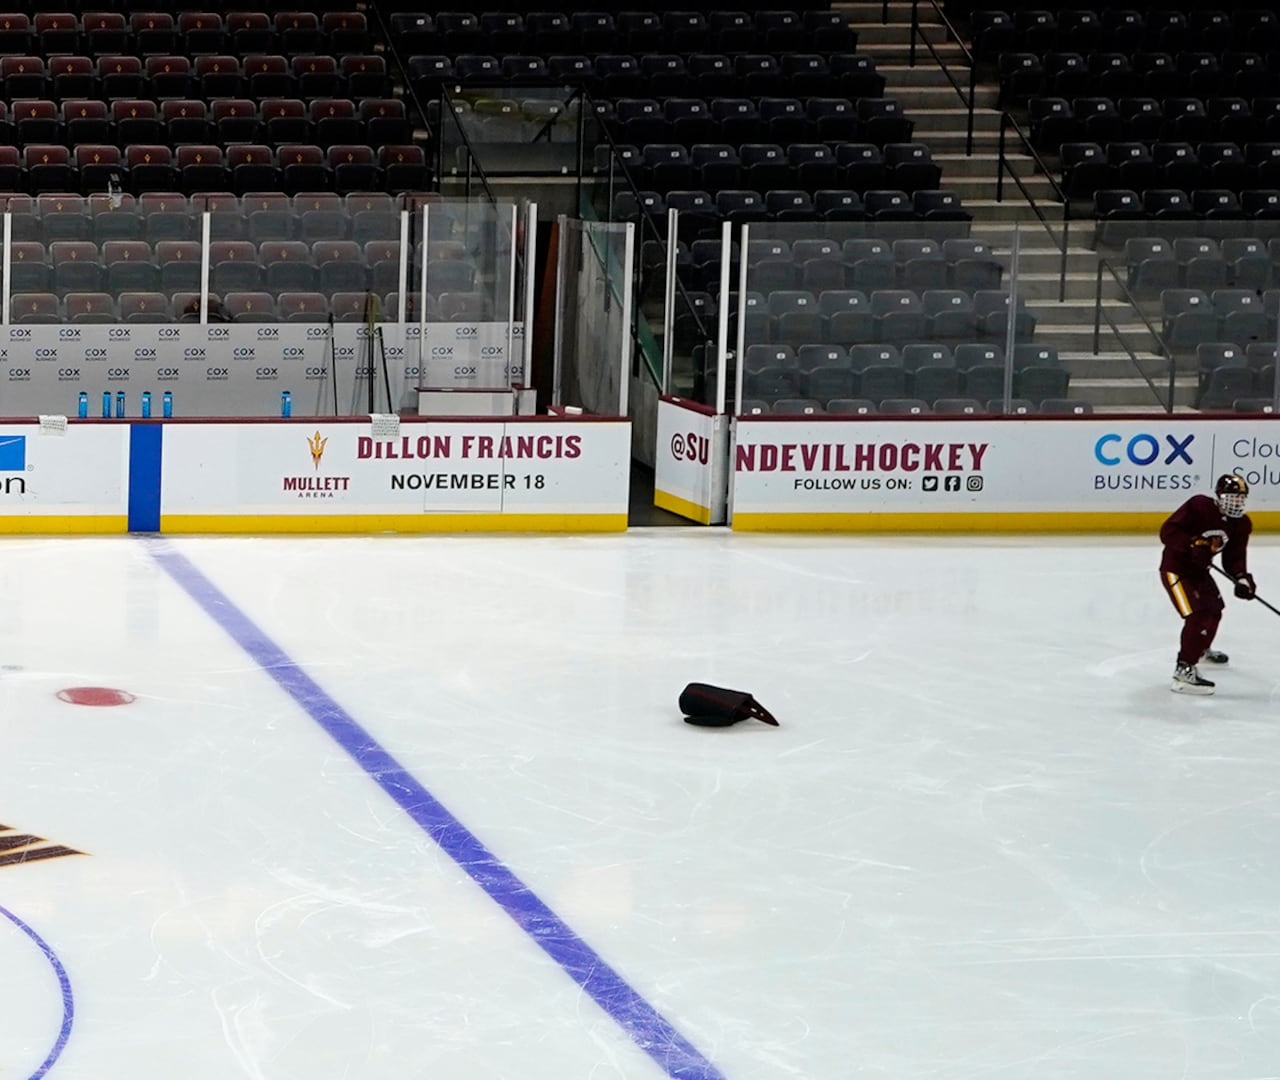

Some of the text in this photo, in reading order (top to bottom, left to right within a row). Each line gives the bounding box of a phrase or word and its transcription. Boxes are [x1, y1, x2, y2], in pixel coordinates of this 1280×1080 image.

[11, 328, 32, 337] COX
[160, 328, 180, 337] COX
[209, 328, 230, 337] COX
[86, 348, 107, 357] COX
[136, 348, 157, 357] COX
[284, 347, 305, 356] COX
[433, 346, 454, 356] COX
[483, 346, 503, 355] COX
[60, 368, 81, 377] COX
[109, 367, 130, 377] COX
[208, 367, 229, 376] COX
[257, 367, 278, 376] COX
[456, 366, 477, 375] COX
[357, 434, 582, 459] DILLON FRANCIS
[1095, 434, 1194, 465] COX
[283, 477, 350, 490] MULLETT
[391, 474, 544, 490] NOVEMBER 18
[794, 478, 911, 489] FOLLOW US ON:
[1094, 475, 1192, 490] BUSINESS
